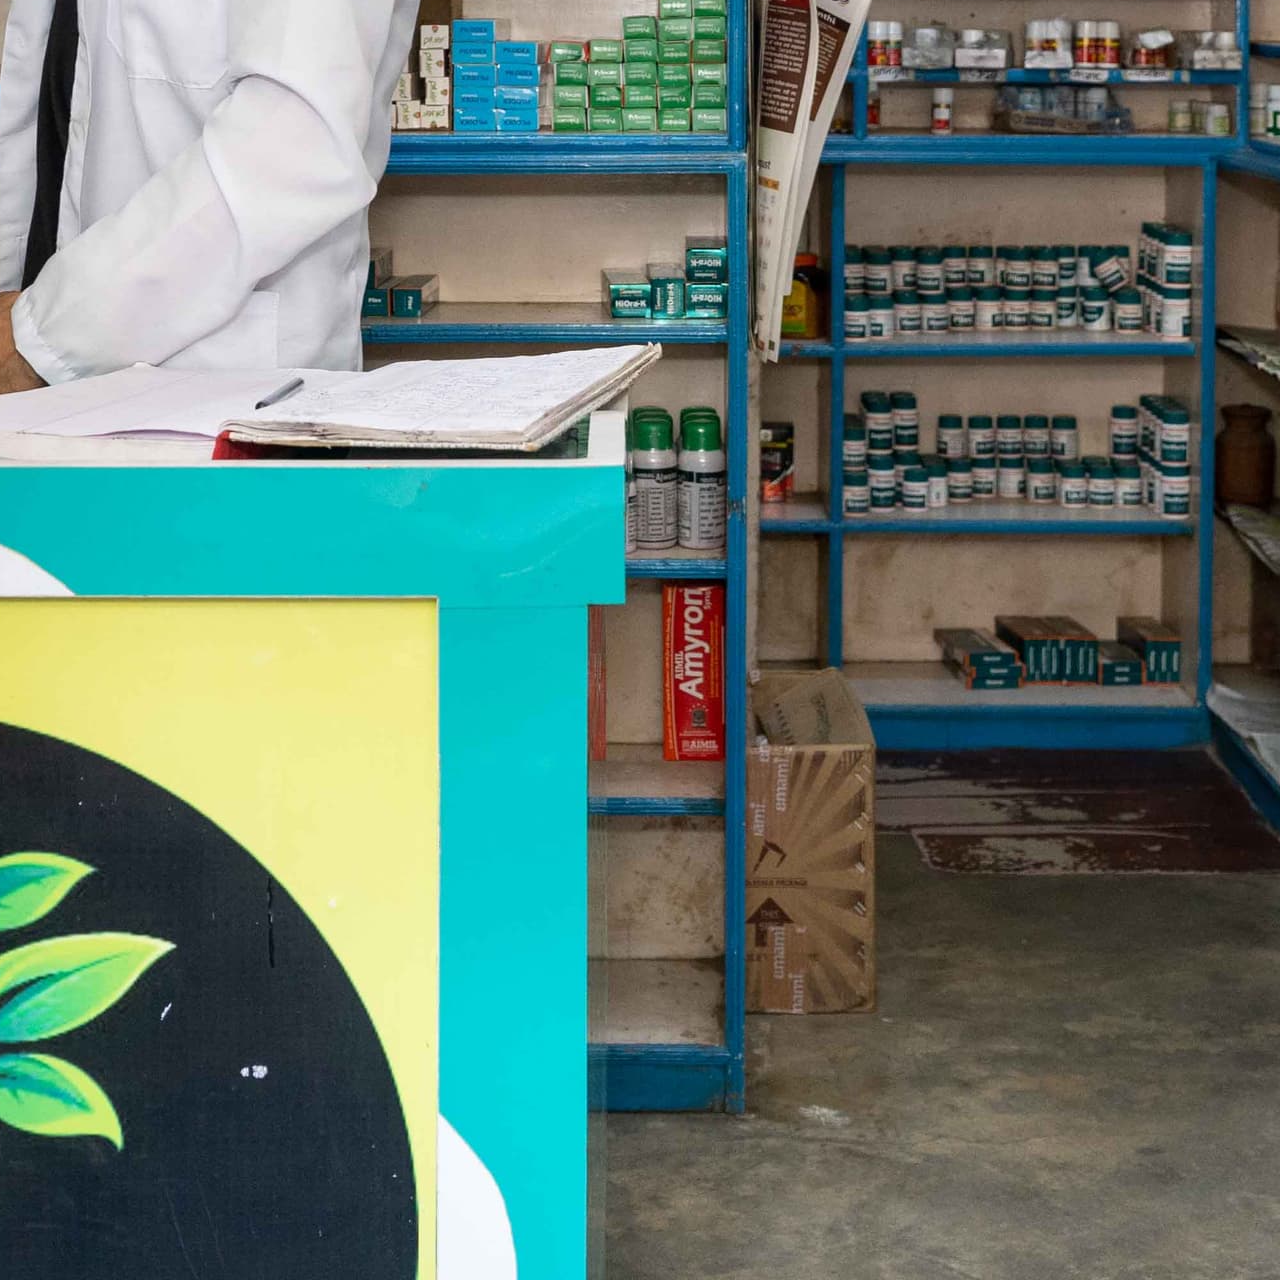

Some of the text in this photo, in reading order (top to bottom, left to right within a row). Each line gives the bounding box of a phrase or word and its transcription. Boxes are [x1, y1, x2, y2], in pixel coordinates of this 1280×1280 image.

[615, 300, 647, 309] HiOra-K
[678, 585, 709, 701] Amyron
[674, 651, 684, 681] AIMIL
[775, 757, 789, 811] emami
